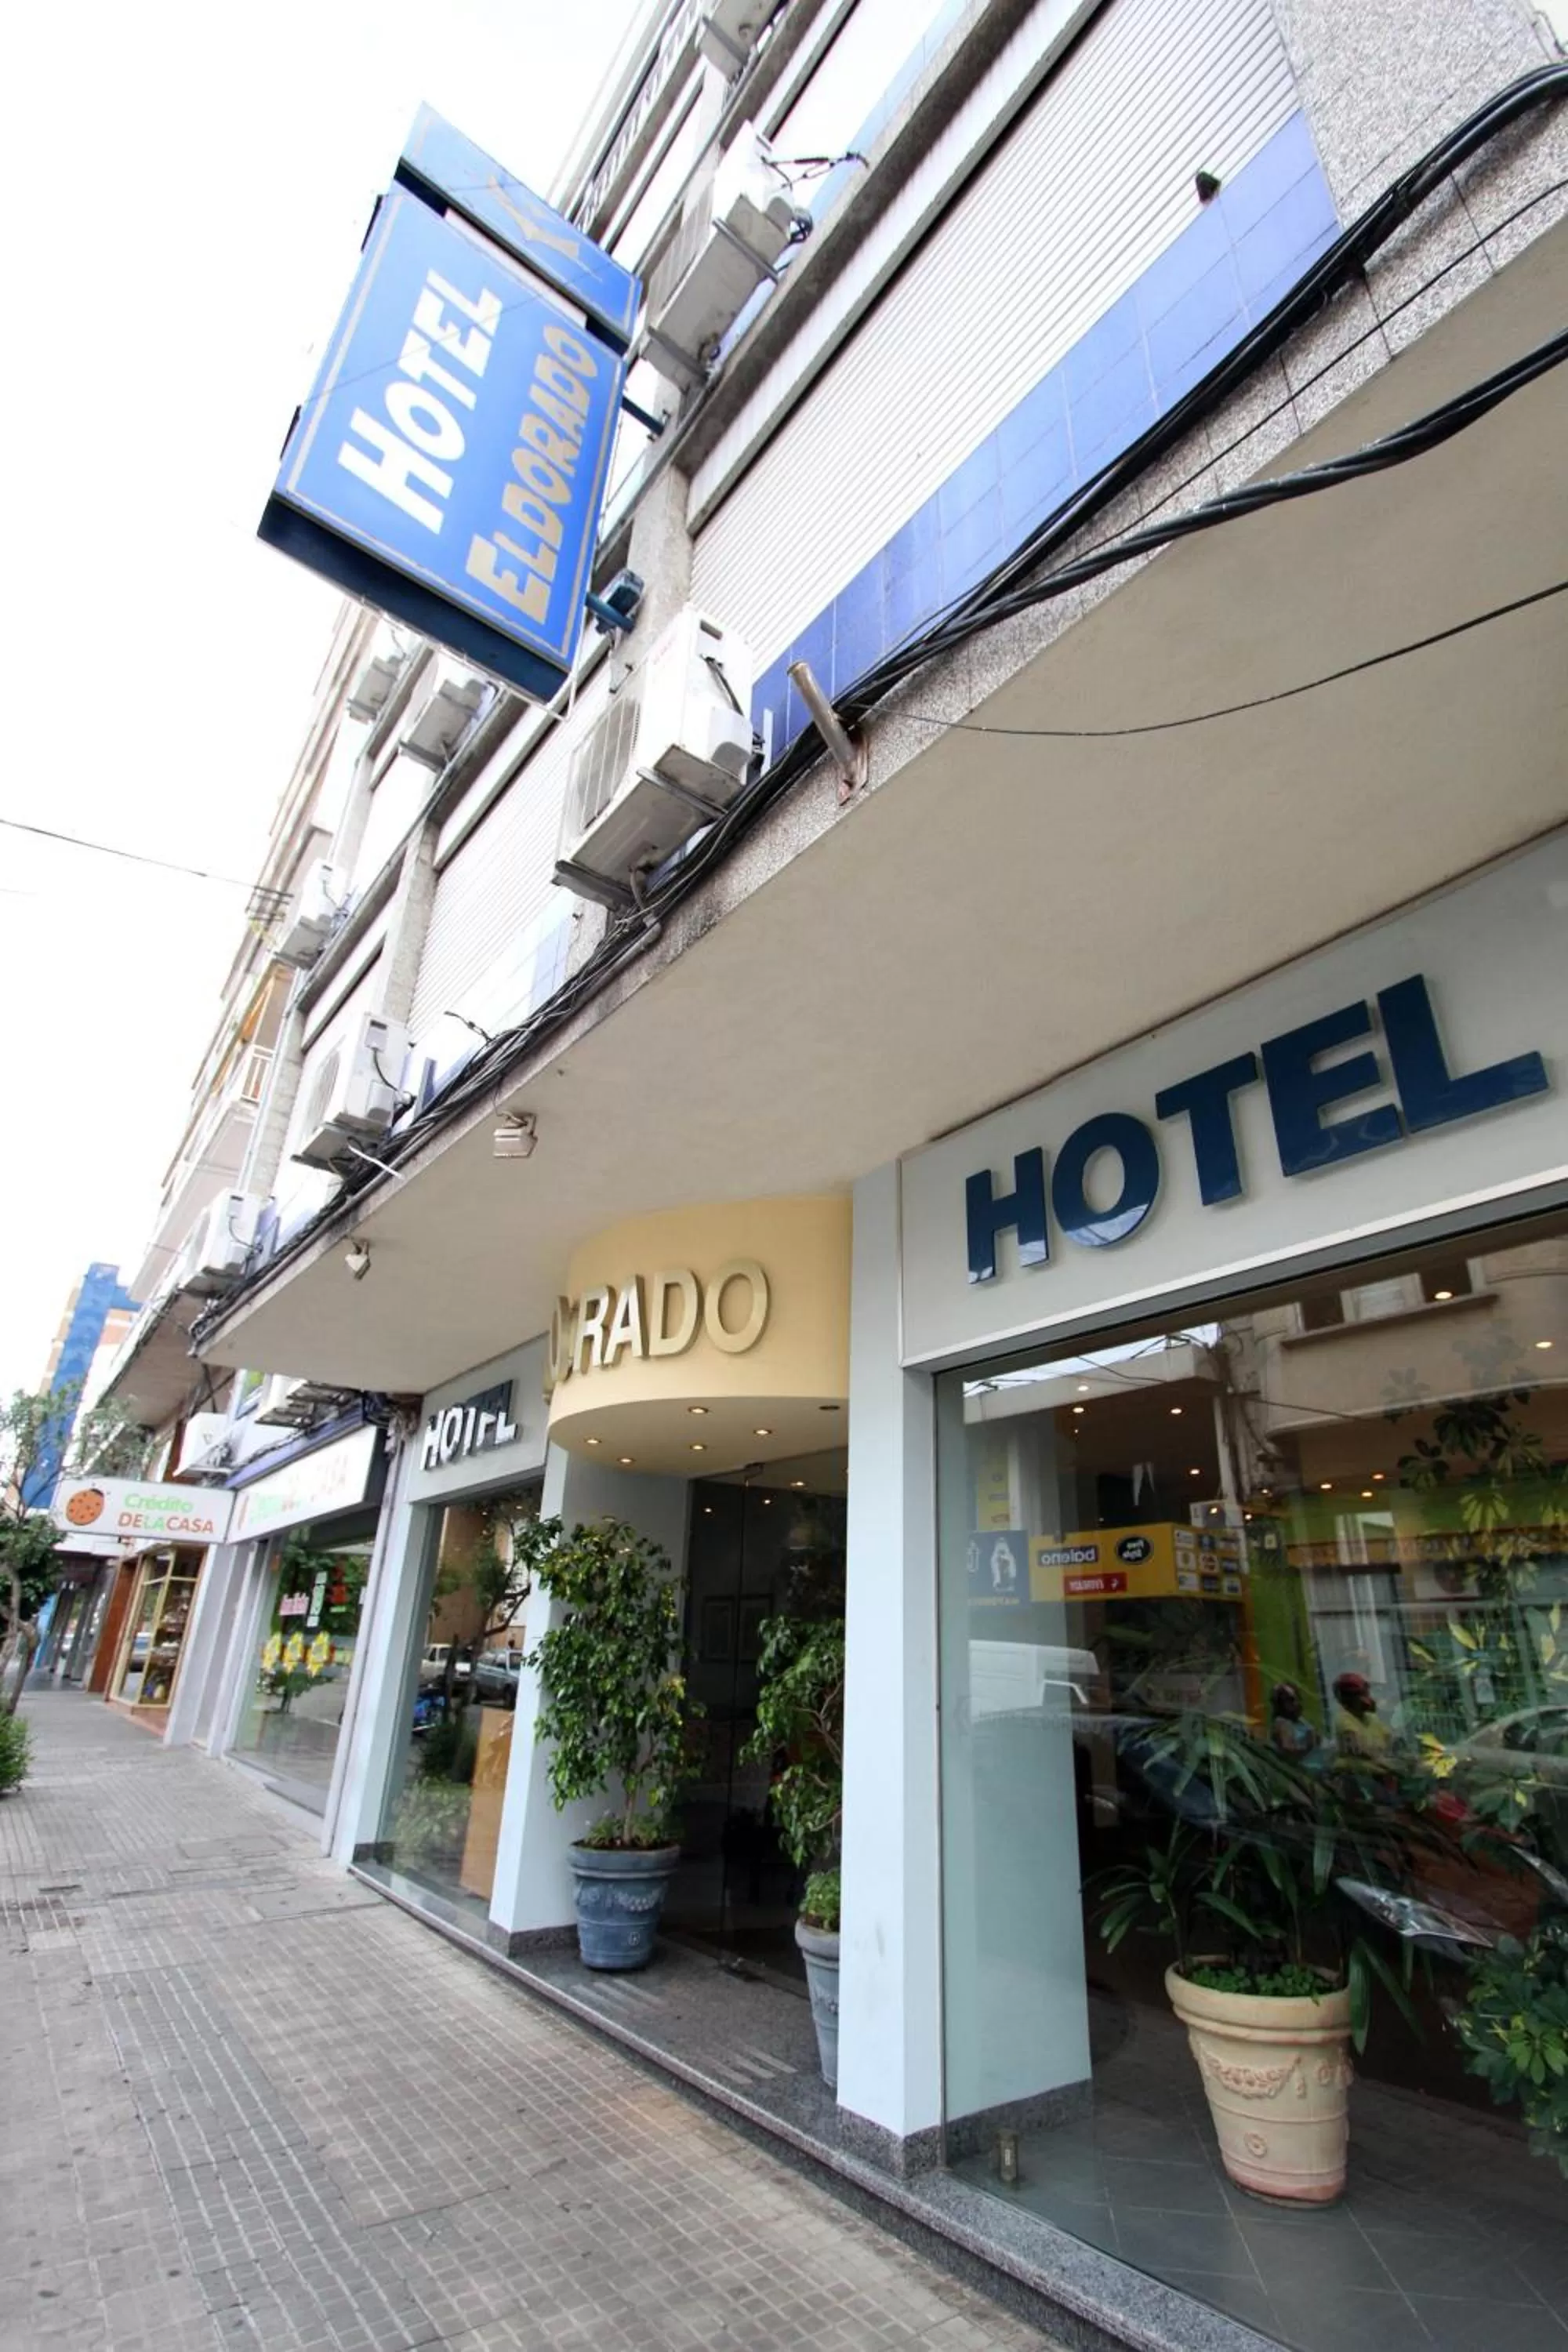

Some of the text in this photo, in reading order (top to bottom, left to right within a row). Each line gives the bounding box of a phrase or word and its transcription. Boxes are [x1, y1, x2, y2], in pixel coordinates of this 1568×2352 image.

[337, 269, 503, 535] HOTEL
[466, 324, 597, 625] ELDORADO
[965, 974, 1549, 1285] HOTEL
[419, 1380, 517, 1471] HOTEL
